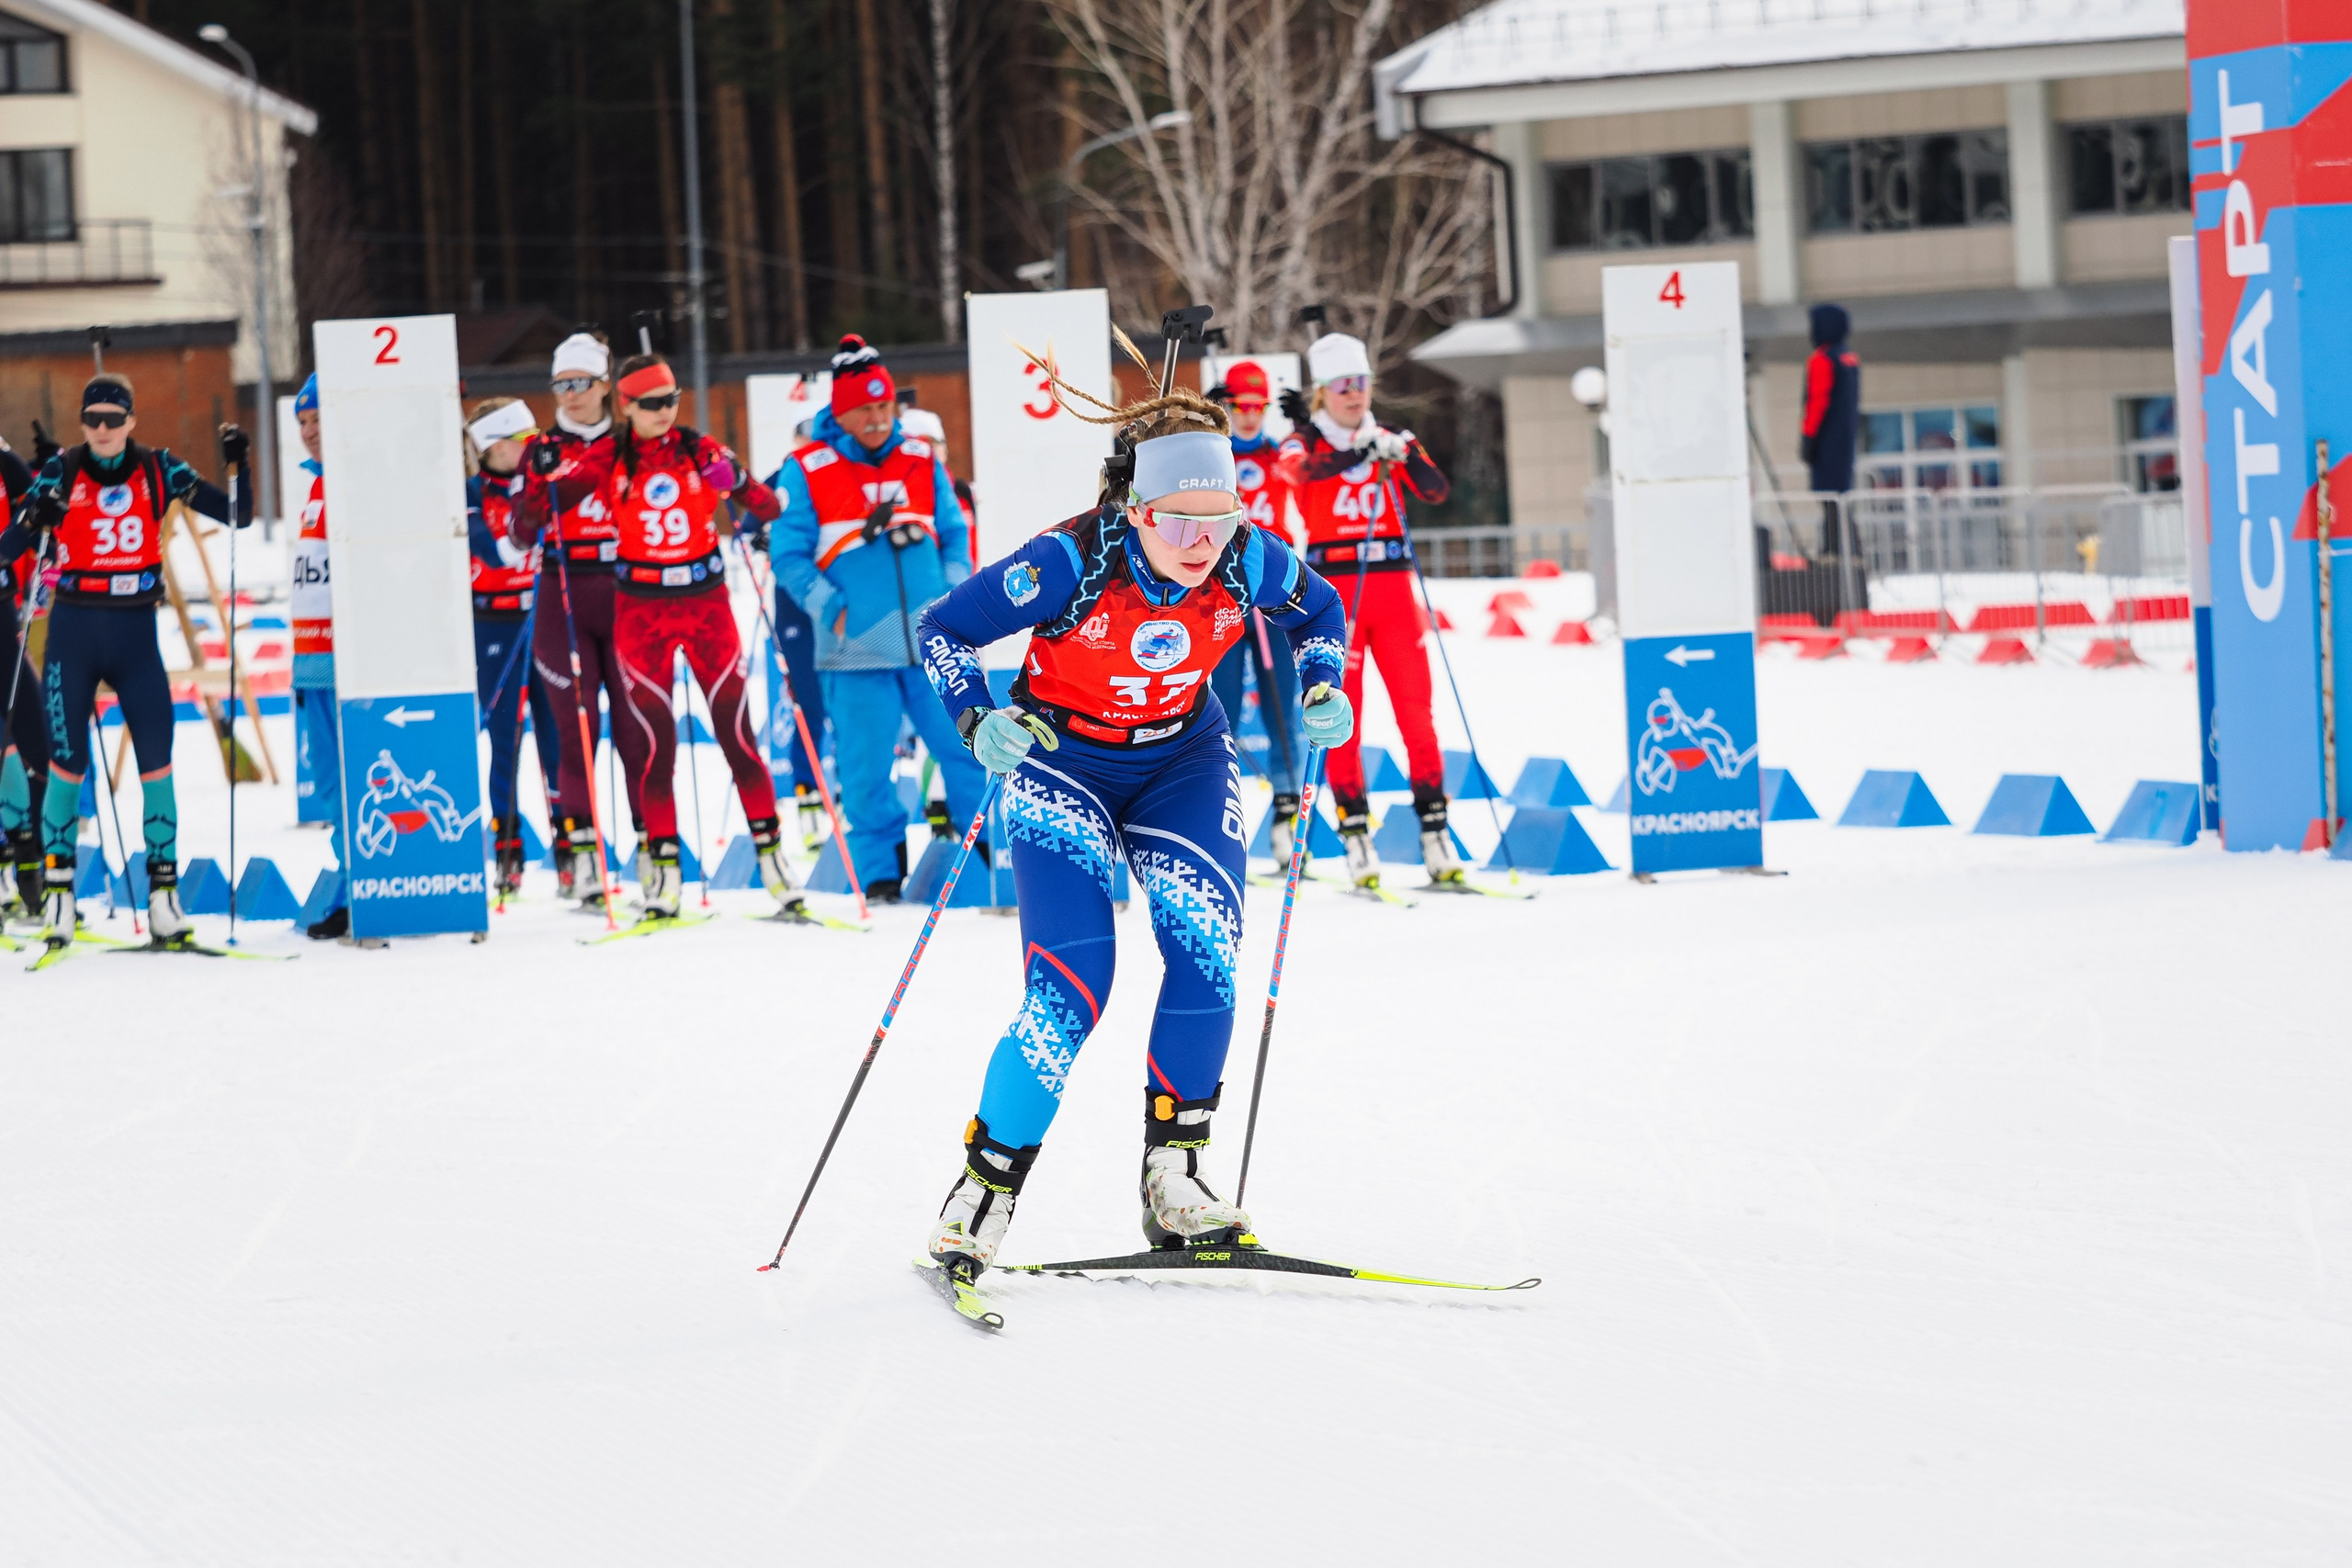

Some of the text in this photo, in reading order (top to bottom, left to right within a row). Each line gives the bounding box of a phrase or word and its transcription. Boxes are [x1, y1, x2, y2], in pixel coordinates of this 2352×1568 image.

[1658, 271, 1687, 309] 4
[373, 325, 401, 366] 2
[2217, 69, 2286, 624] СТАРТ
[1022, 358, 1060, 420] 3
[1179, 478, 1224, 490] CRAFT
[1332, 482, 1386, 521] 40
[639, 508, 691, 547] 39
[1242, 491, 1274, 526] 4
[90, 515, 144, 556] 38
[924, 635, 969, 697] ЯМАЛ
[1108, 669, 1204, 707] 37
[1631, 808, 1760, 836] КРАСНОЯРСК
[352, 872, 484, 901] КРАСНОЯРСК
[1194, 1252, 1231, 1261] FISCHER
